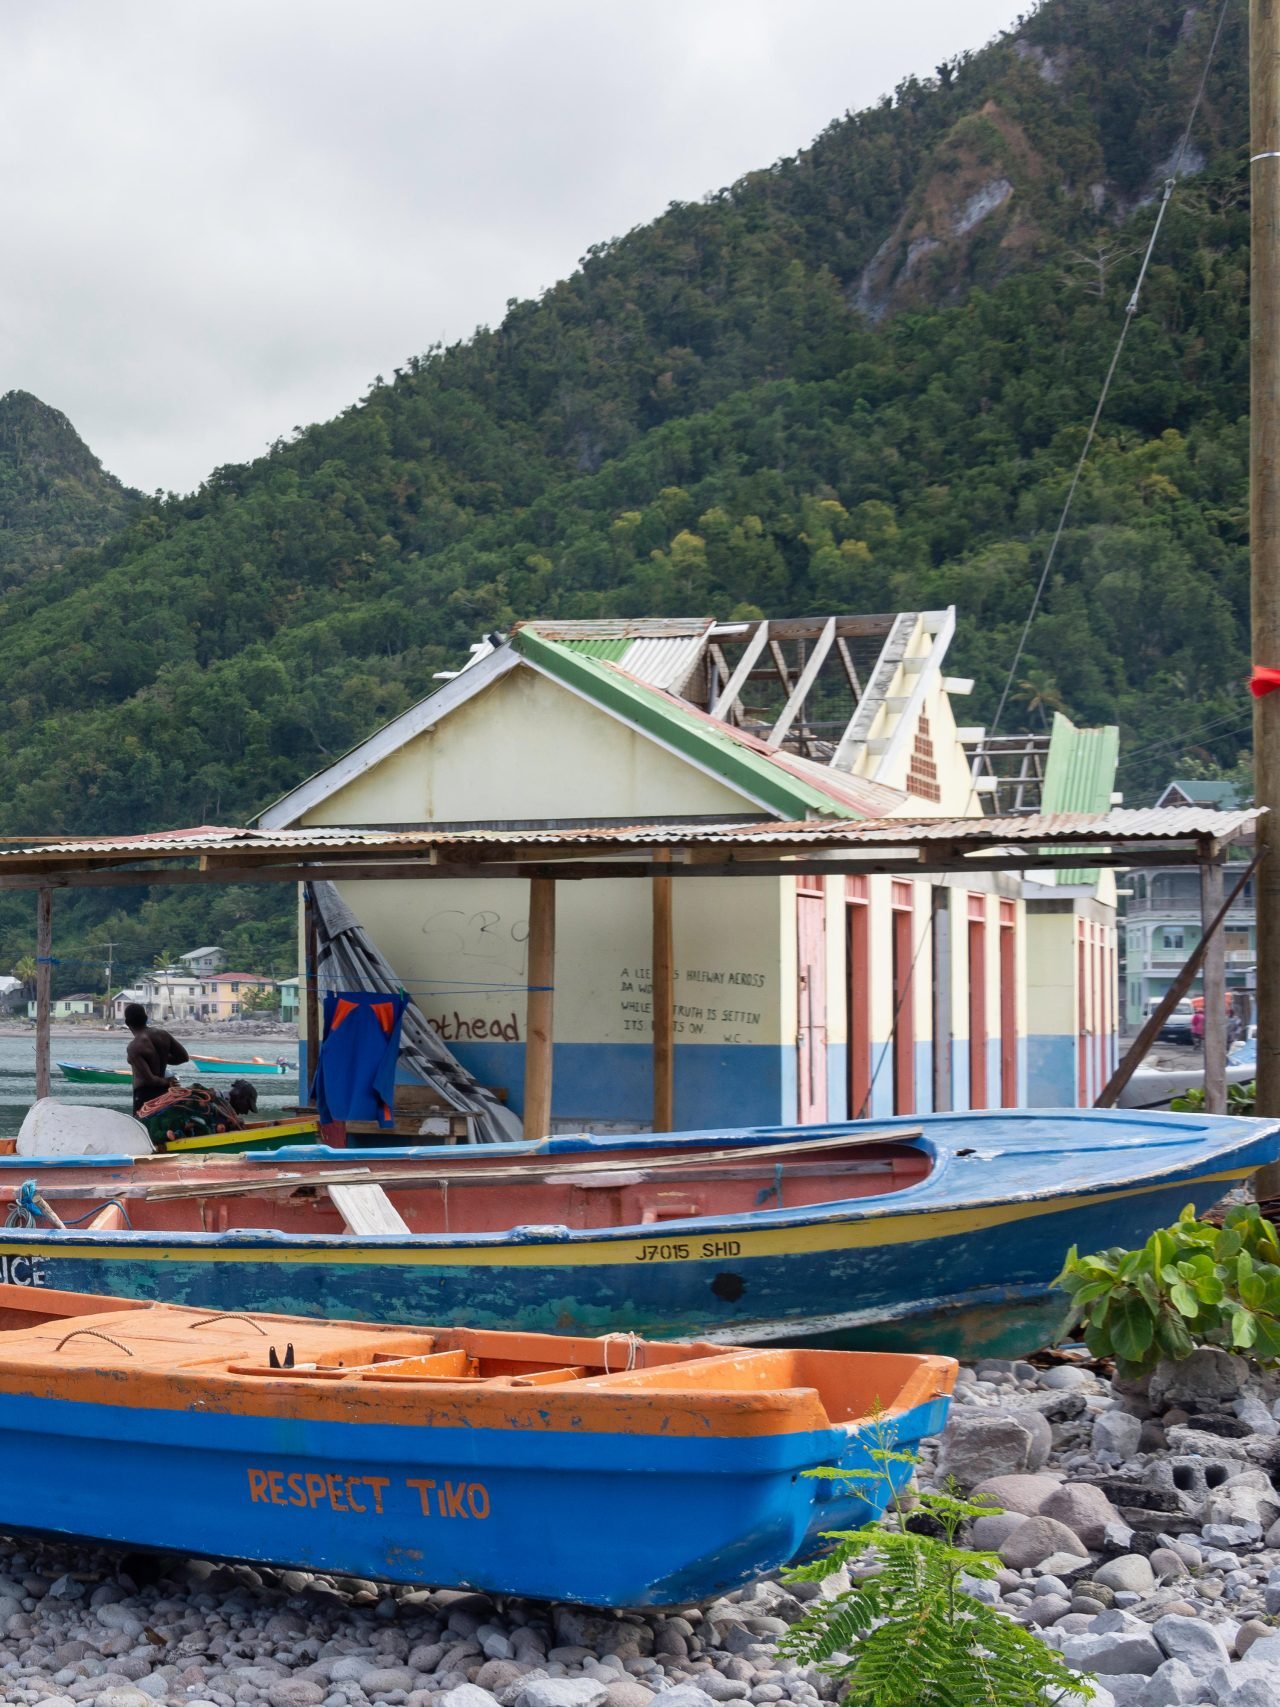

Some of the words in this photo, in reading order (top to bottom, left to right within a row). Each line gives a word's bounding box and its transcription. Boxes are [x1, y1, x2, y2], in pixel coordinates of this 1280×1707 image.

[620, 968, 629, 978] A
[635, 968, 651, 980] LIE
[639, 984, 654, 994] WO
[621, 1001, 652, 1013] WHILE
[672, 1004, 703, 1019] TRUTH
[707, 1008, 717, 1021] IS
[427, 1010, 520, 1042] othead
[635, 1244, 690, 1261] J7015
[247, 1468, 390, 1514] RESPECT
